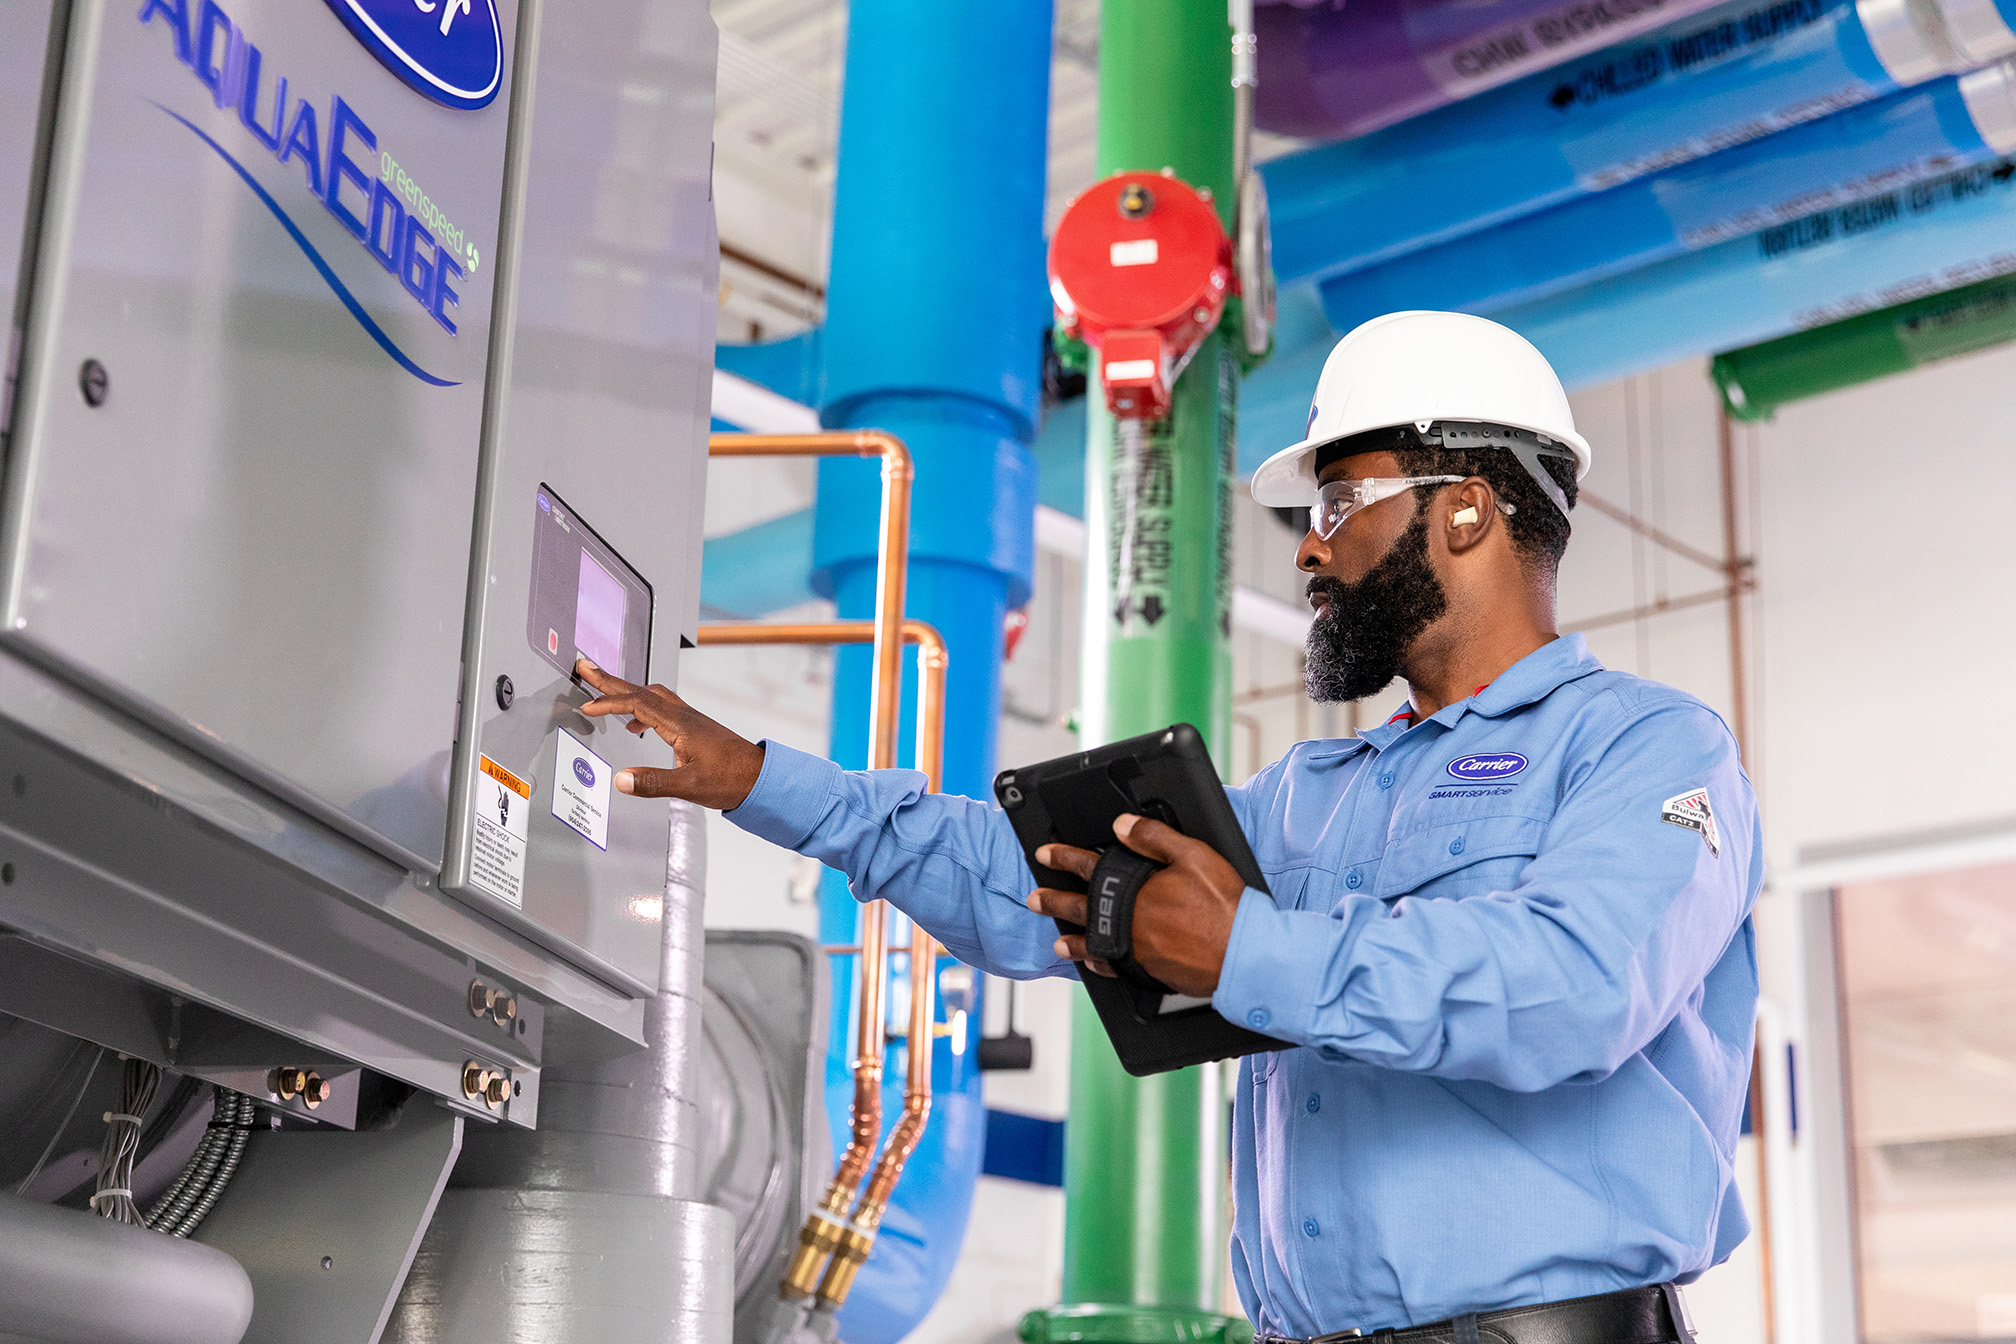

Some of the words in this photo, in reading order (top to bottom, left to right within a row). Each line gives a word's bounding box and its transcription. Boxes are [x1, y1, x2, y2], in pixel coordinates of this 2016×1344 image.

[381, 151, 464, 256] greenspeed
[575, 761, 594, 782] Carrier
[1458, 757, 1518, 771] Carrier
[1671, 804, 1705, 819] Bulwa
